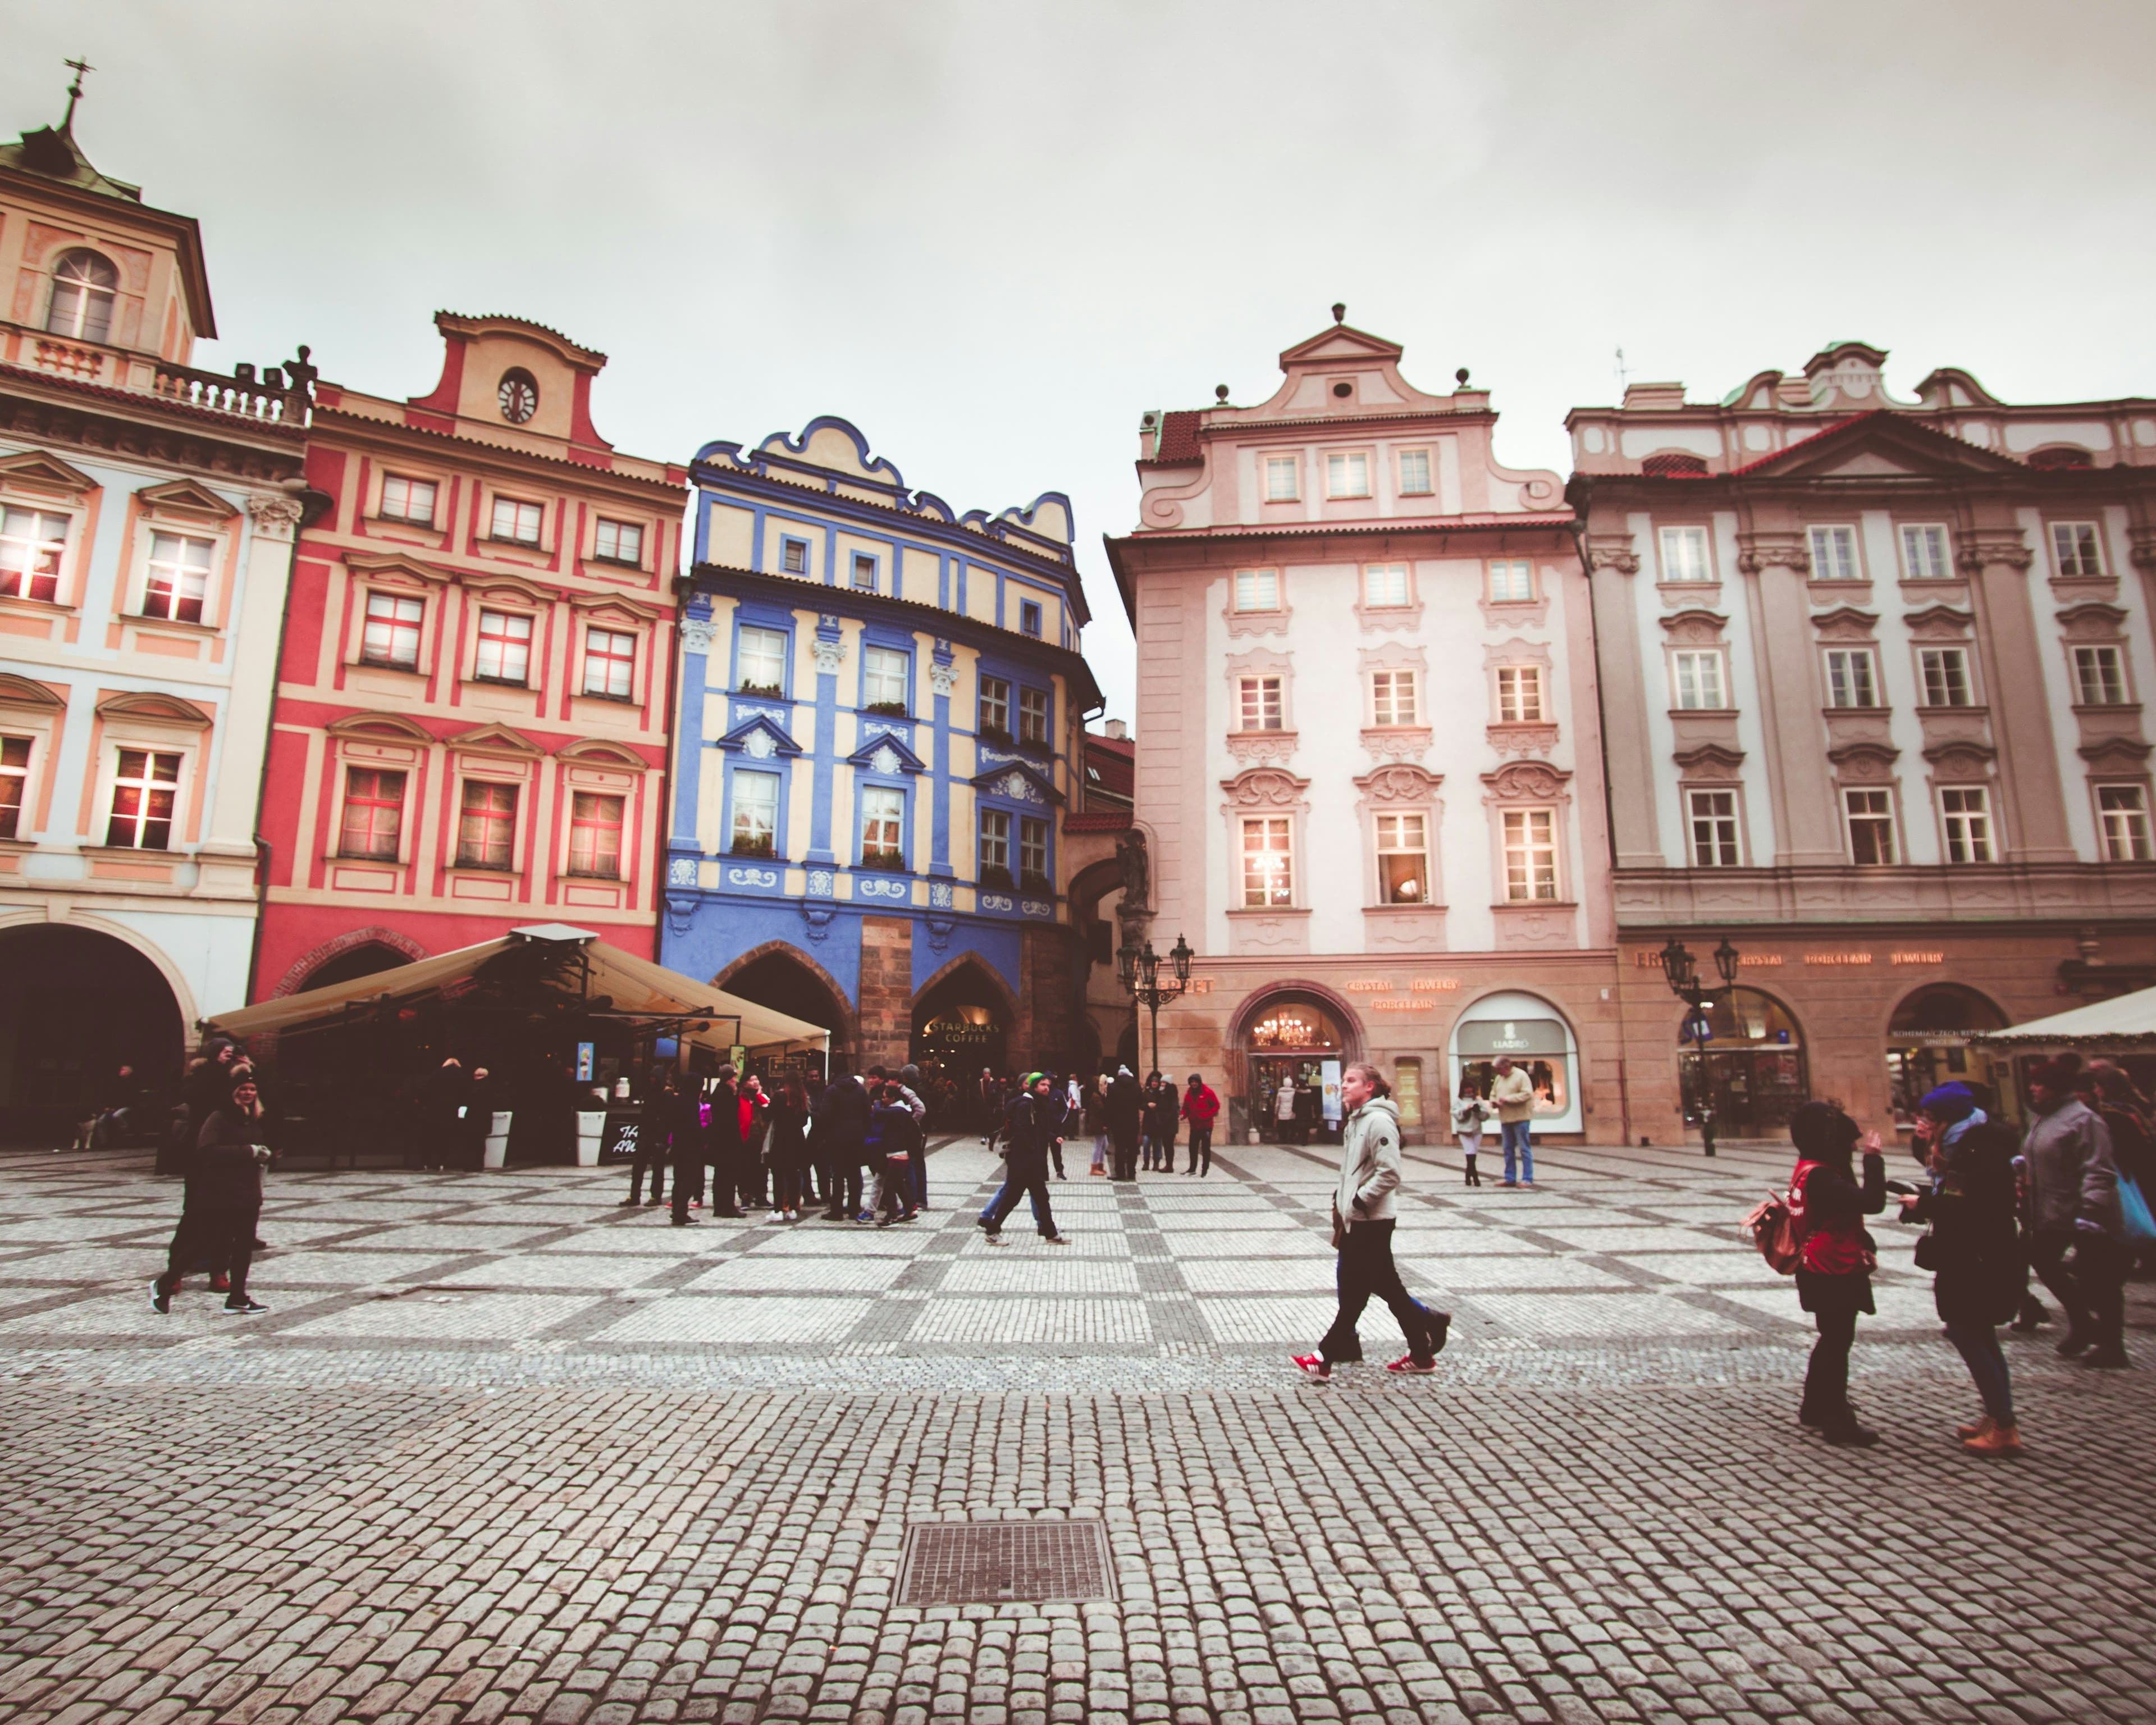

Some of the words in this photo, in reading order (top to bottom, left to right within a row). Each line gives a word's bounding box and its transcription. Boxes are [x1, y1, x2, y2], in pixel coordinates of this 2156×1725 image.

[1347, 982, 1392, 991] CRYSTAL
[1412, 980, 1460, 991] JEWELRY
[1373, 1000, 1435, 1010] PORCELAIN
[933, 1023, 1000, 1033] STARBUCKS
[945, 1033, 988, 1043] COFFEE
